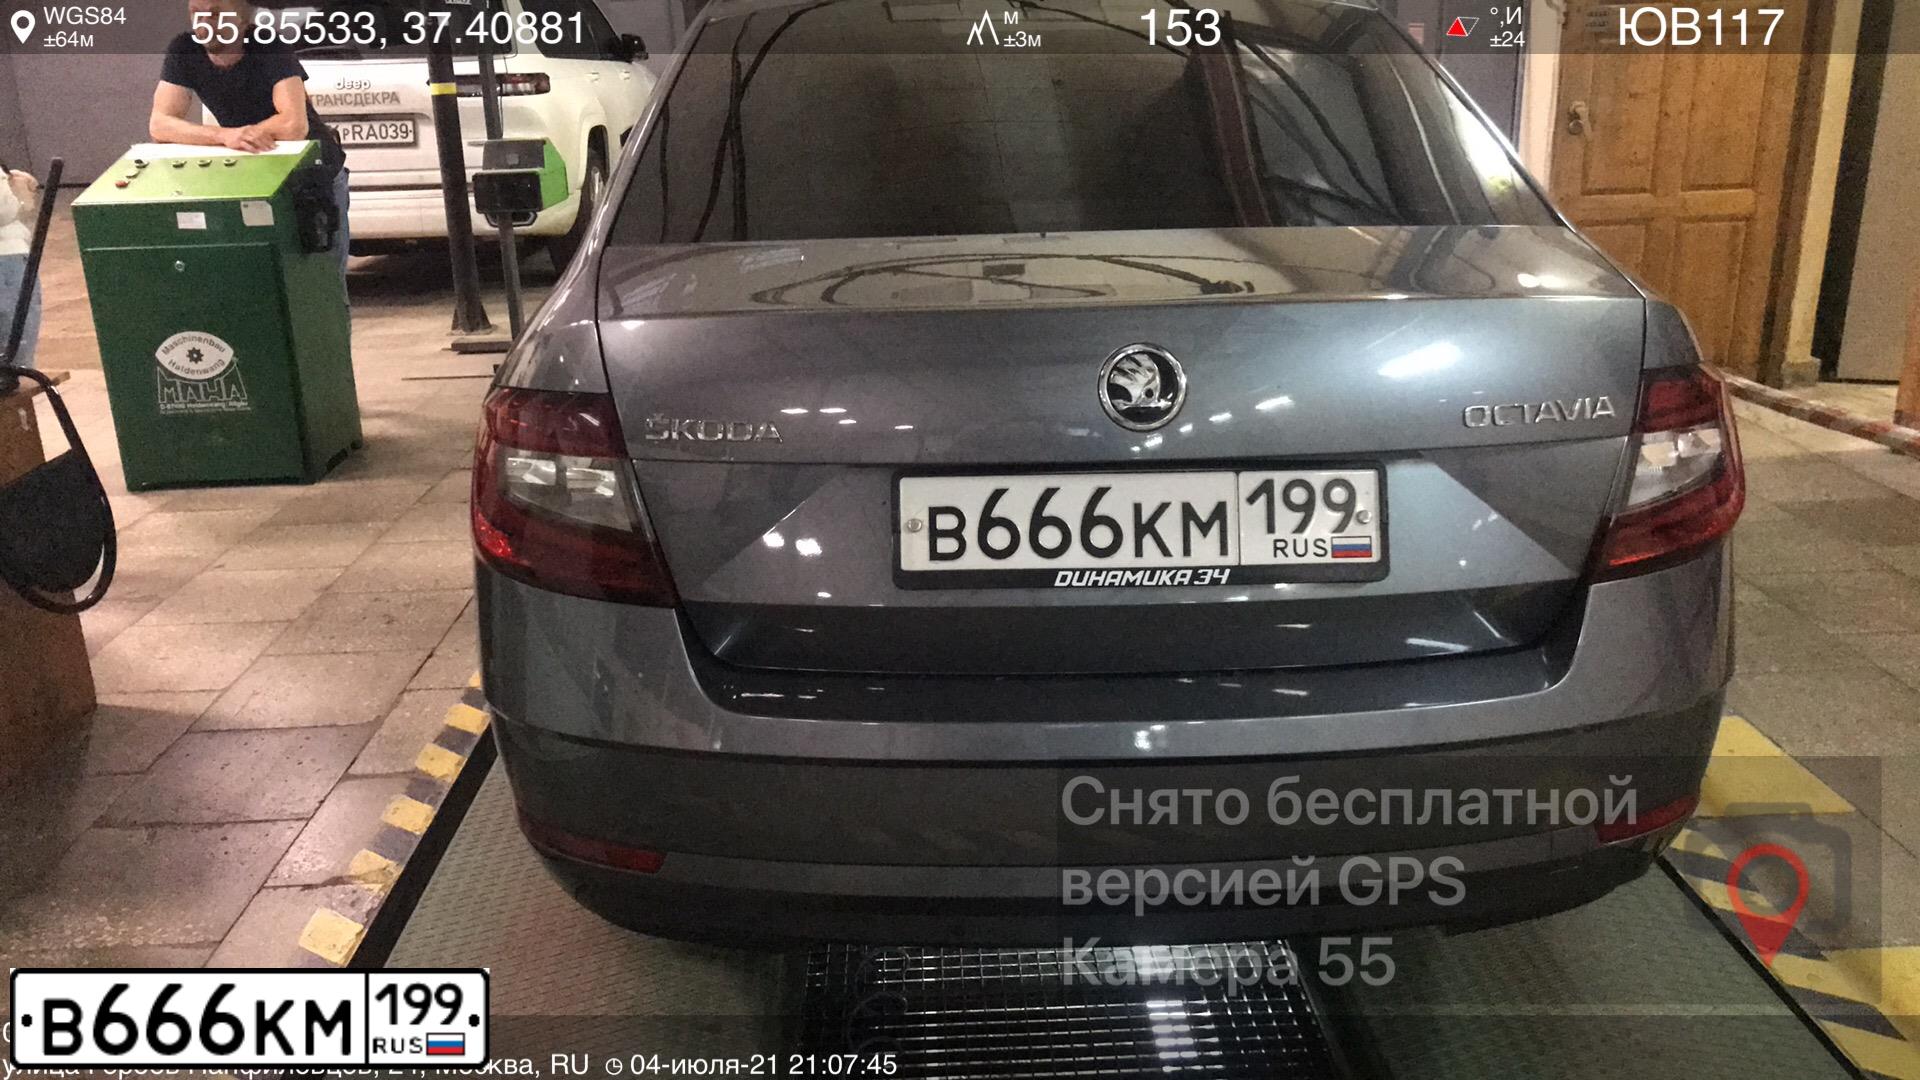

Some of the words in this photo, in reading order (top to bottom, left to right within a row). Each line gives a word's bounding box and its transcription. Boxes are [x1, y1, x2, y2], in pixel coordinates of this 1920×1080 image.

[157, 366, 248, 403] MAHA
[1464, 395, 1616, 428] OCTAVIA
[928, 486, 1229, 562] В666КМ
[1245, 478, 1357, 535] 199
[1272, 537, 1329, 559] RUS
